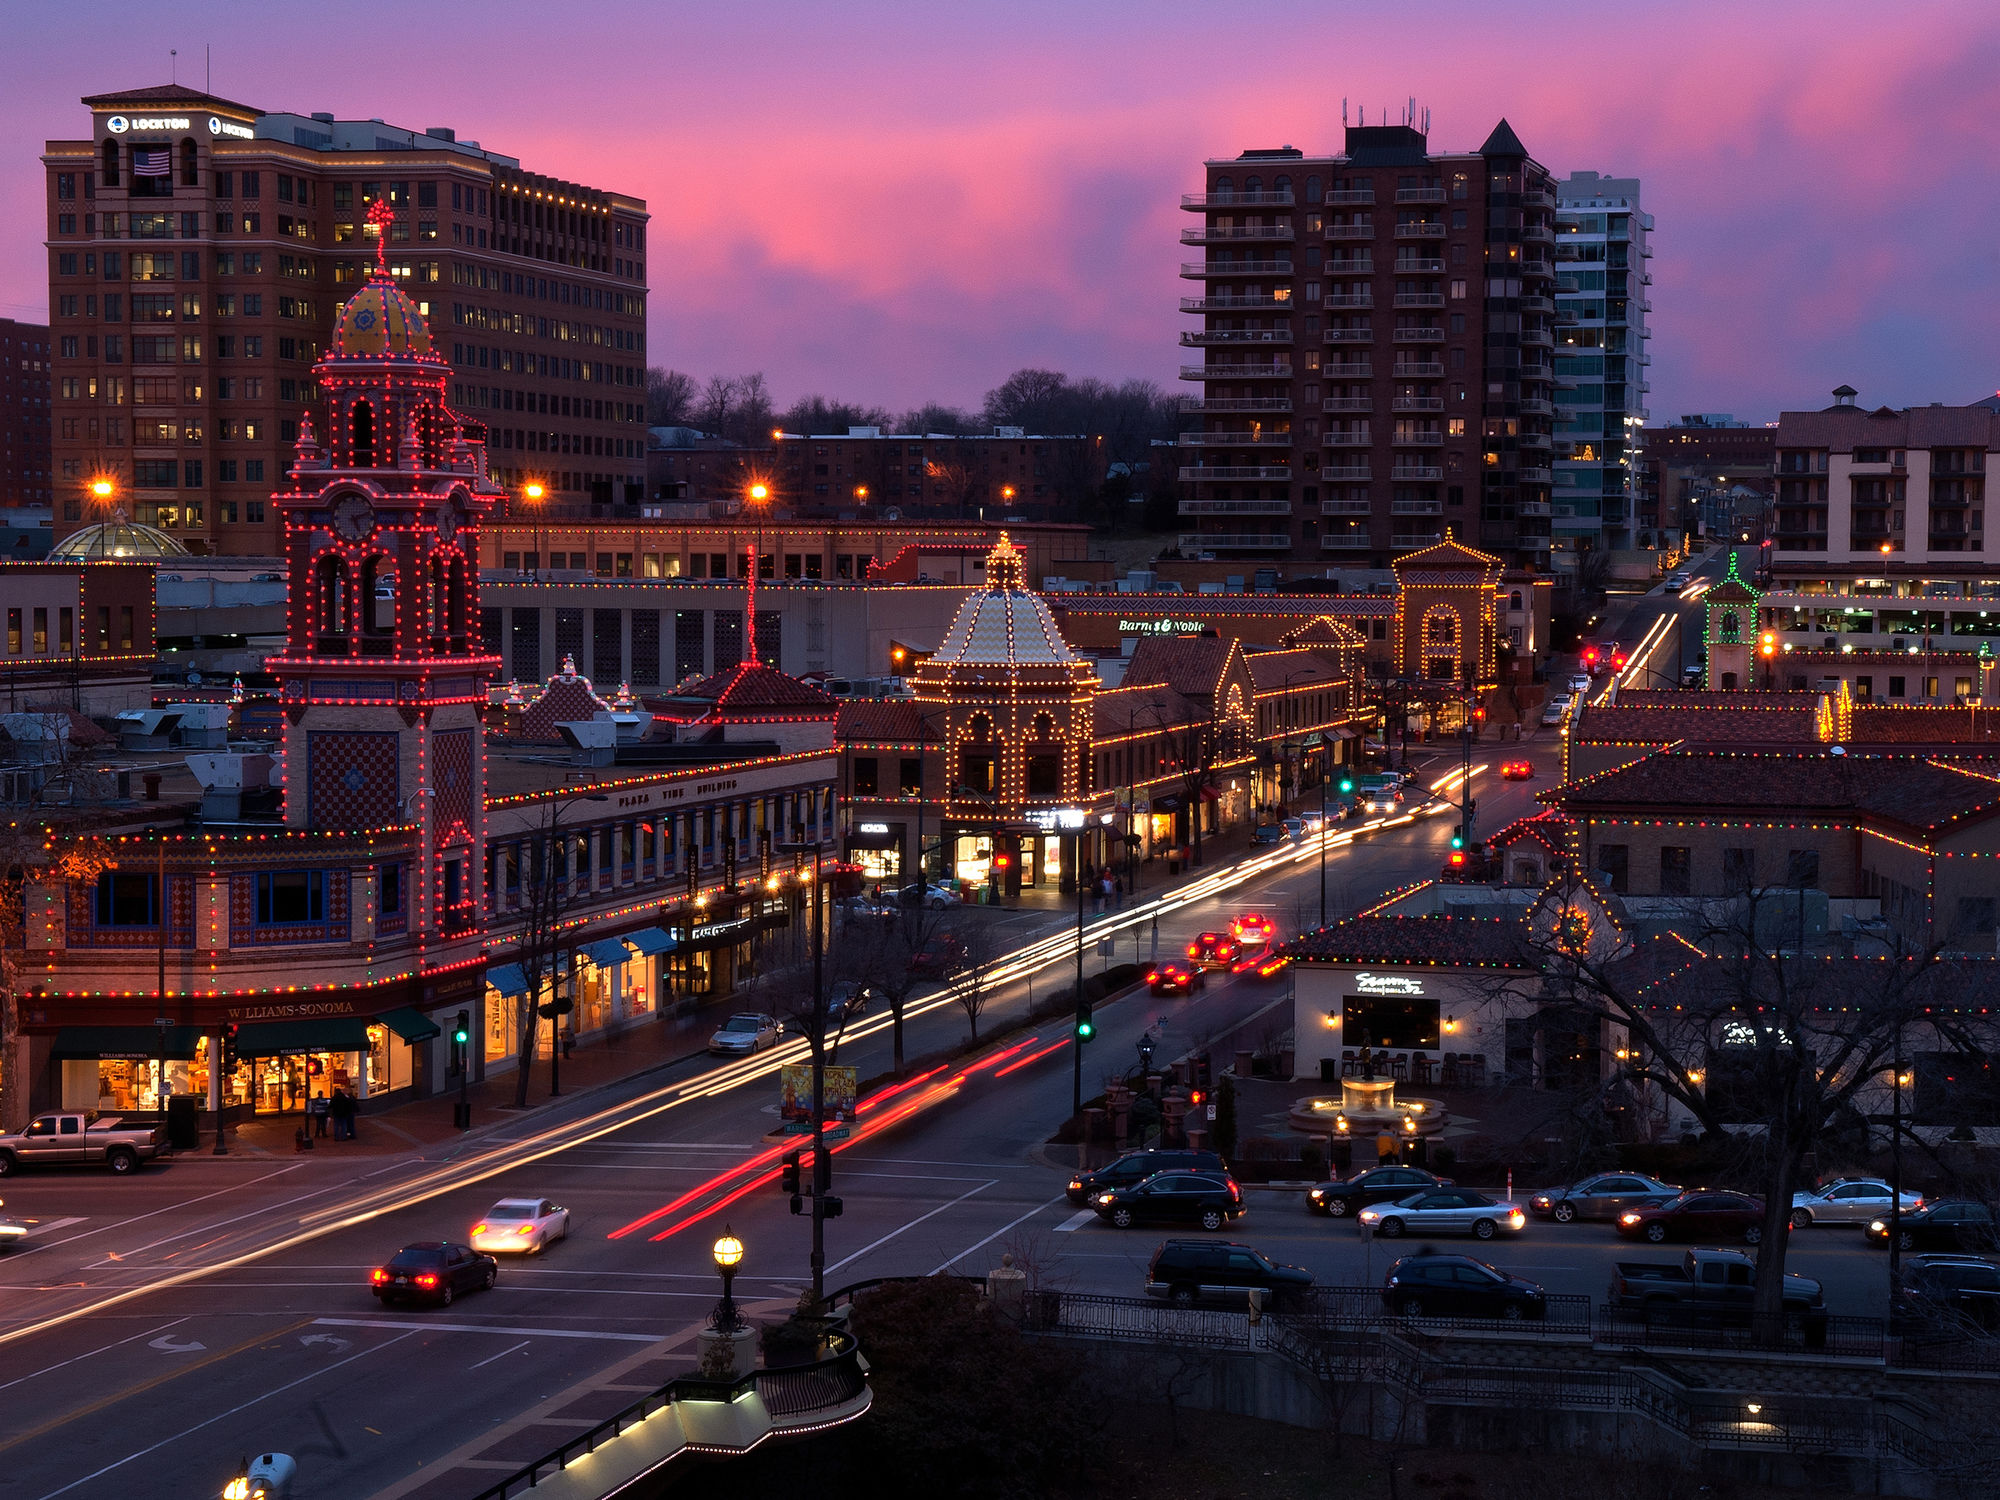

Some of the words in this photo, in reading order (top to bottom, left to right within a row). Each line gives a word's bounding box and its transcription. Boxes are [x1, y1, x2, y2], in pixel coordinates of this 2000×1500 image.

[132, 118, 190, 130] LOCKTON
[1160, 618, 1172, 632] &
[1173, 621, 1205, 632] Noble
[618, 794, 650, 808] PLAZA
[662, 788, 685, 800] TIME
[697, 780, 738, 795] BUILDING
[228, 1001, 354, 1019] WLLIAMS-SONOMA
